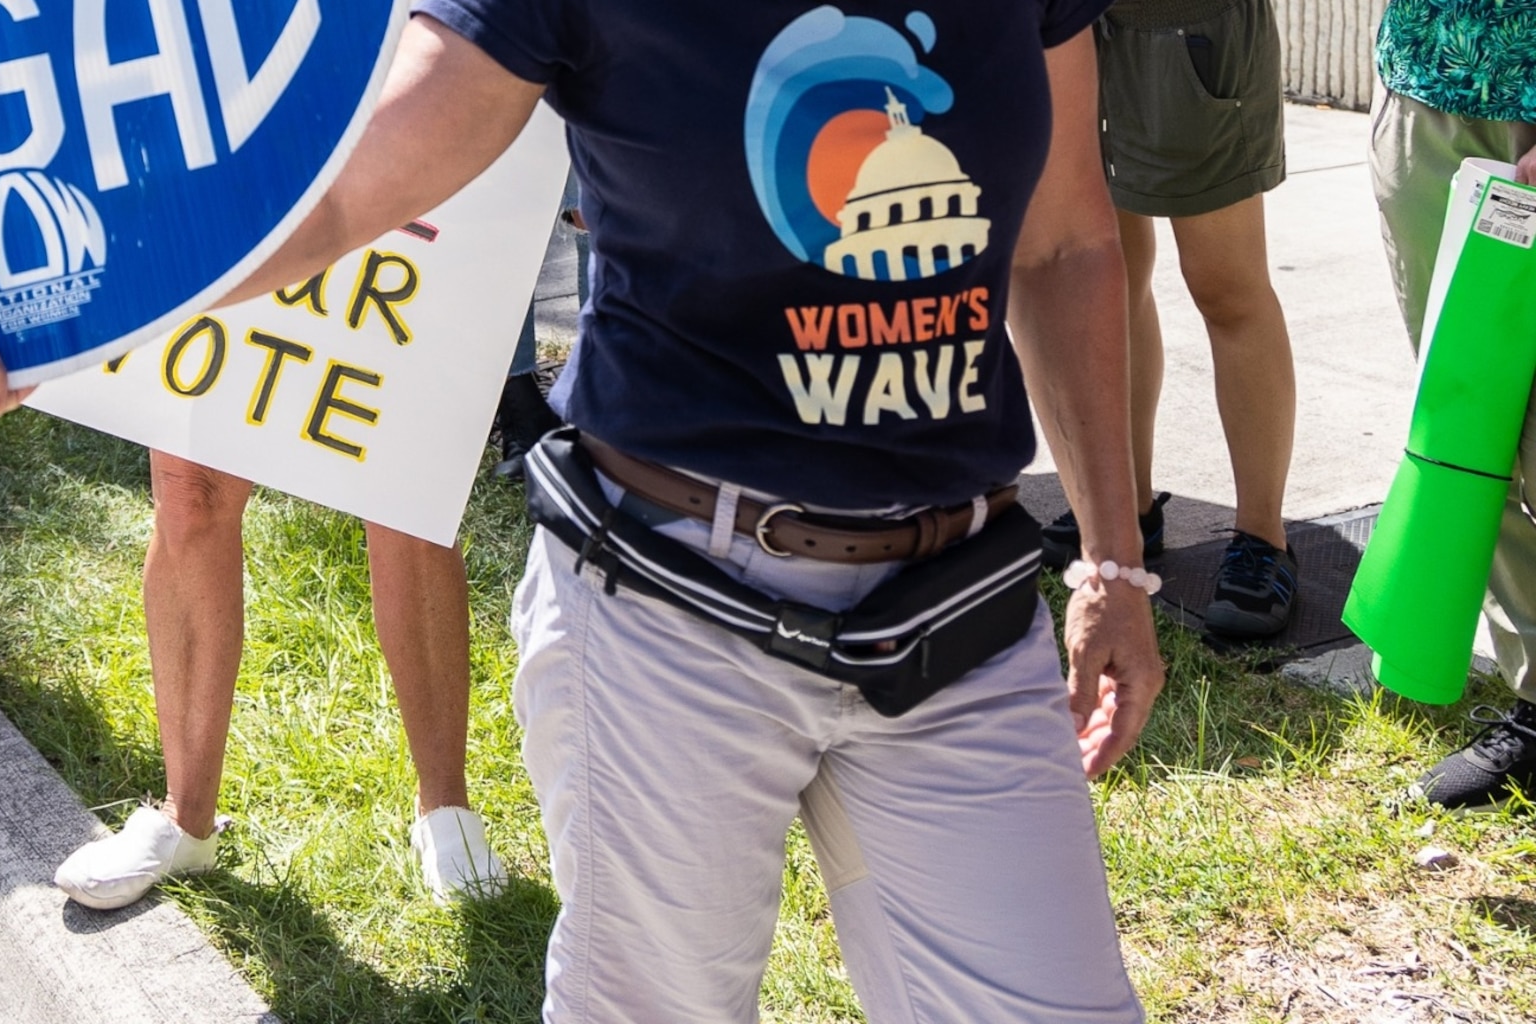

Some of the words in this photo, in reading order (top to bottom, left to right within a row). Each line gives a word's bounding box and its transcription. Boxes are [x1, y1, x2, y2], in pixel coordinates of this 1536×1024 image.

[29, 306, 79, 325] WOMEN
[785, 286, 989, 350] WOMEN'S
[103, 314, 383, 463] OTE
[778, 340, 987, 426] WAVE
